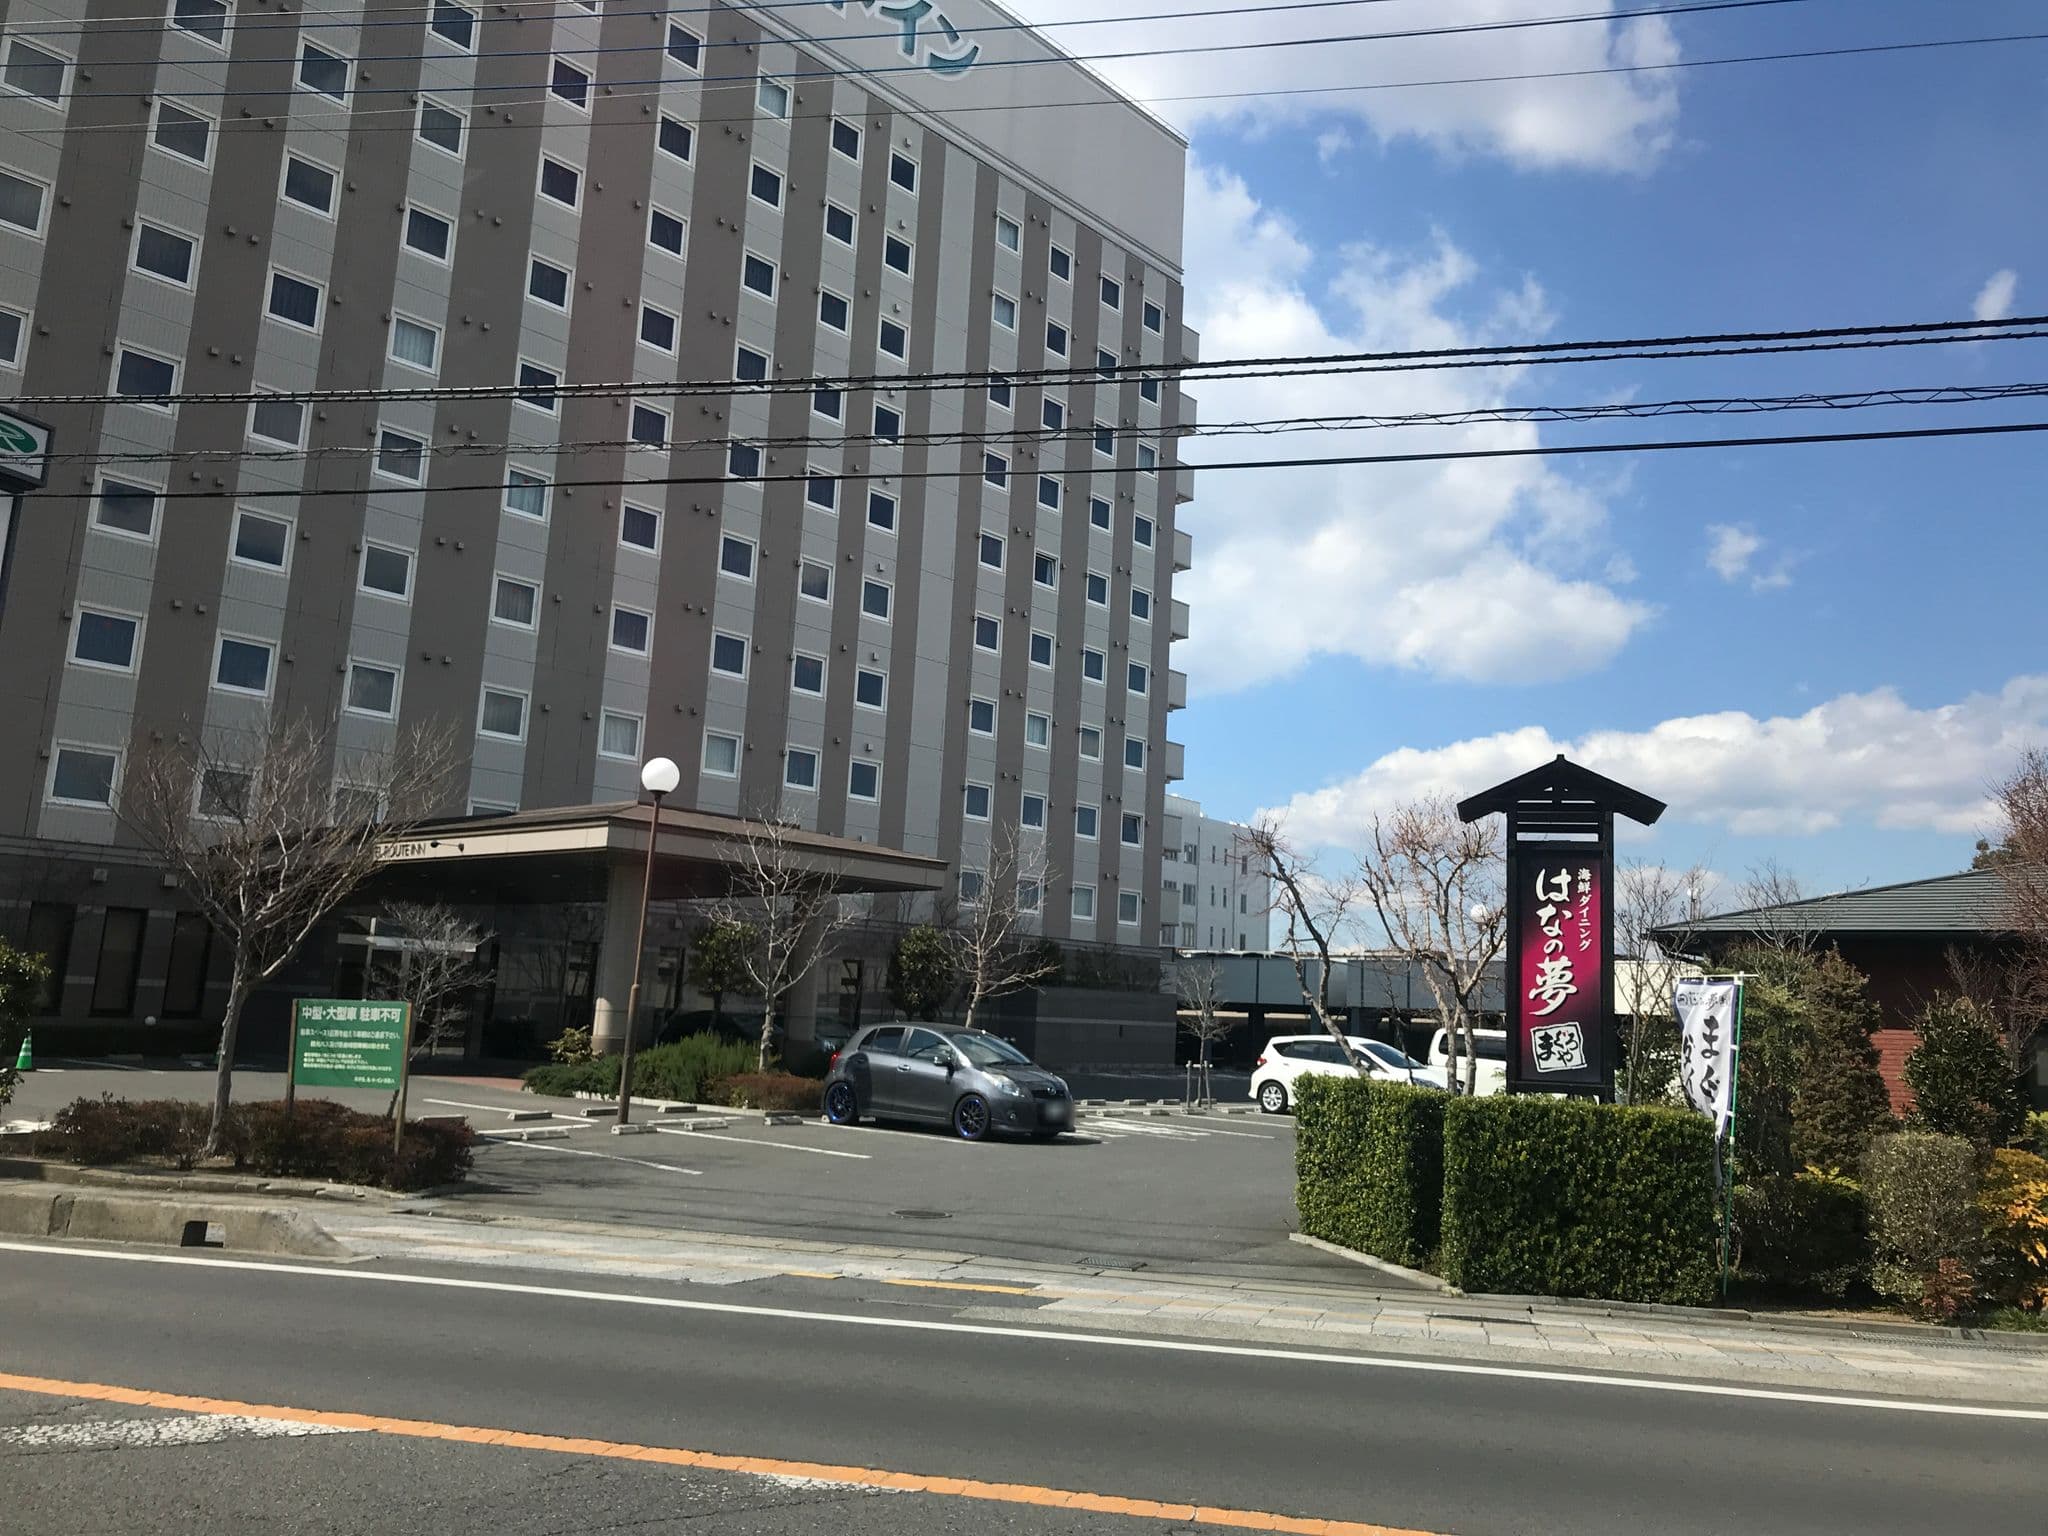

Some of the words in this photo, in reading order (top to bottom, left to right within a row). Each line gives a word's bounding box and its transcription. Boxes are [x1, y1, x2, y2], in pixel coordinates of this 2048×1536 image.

[829, 0, 980, 75] イン
[1528, 867, 1579, 1016] はなの夢
[1577, 867, 1592, 952] 海鮮ダイニング
